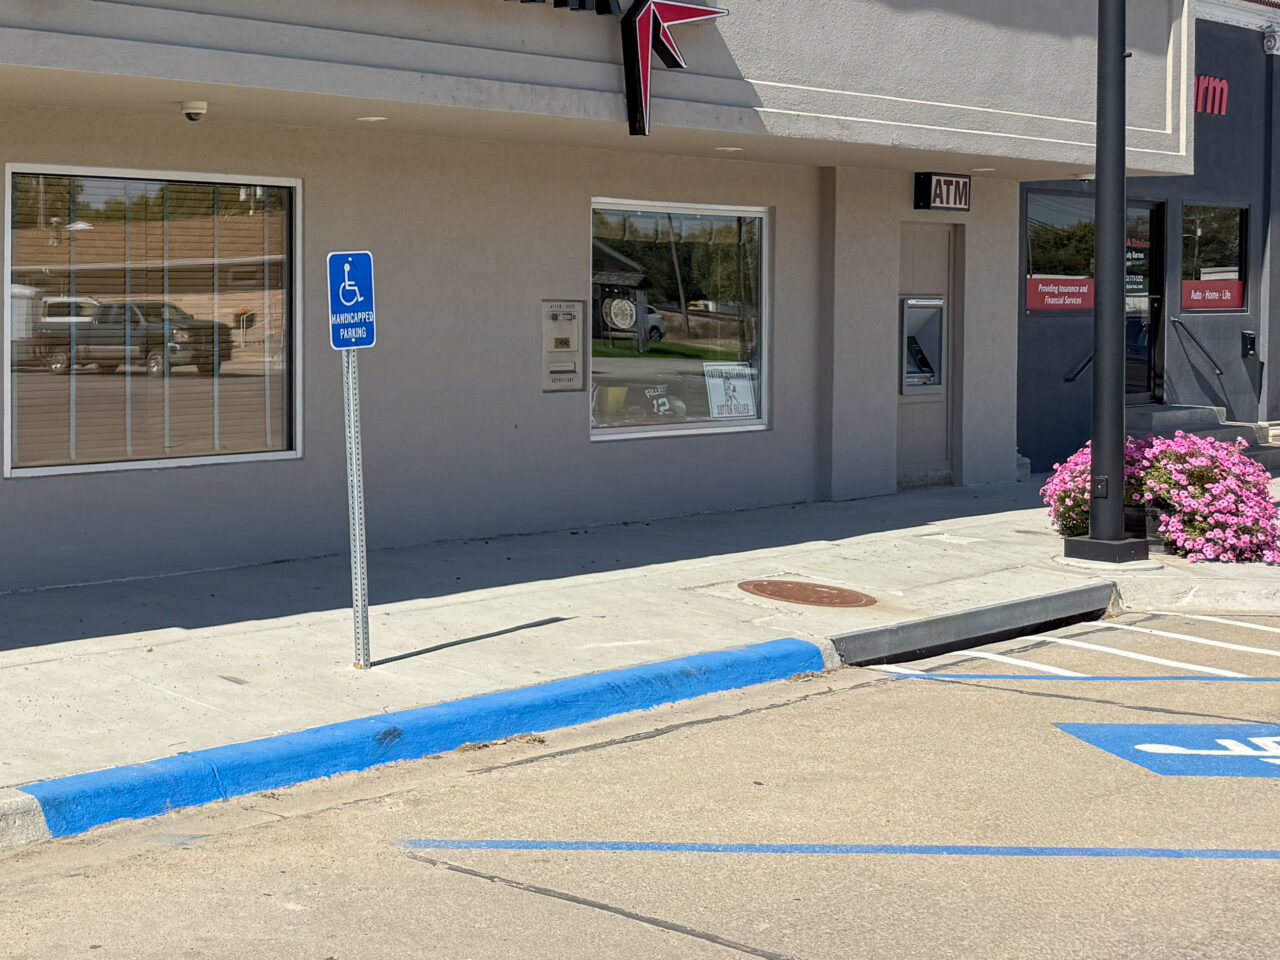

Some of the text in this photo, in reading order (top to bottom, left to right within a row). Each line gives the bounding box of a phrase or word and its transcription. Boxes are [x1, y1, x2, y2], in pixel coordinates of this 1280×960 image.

[932, 178, 968, 206] ATM
[1038, 283, 1088, 294] Providing Insurance and
[1191, 289, 1231, 300] Auto Home Life
[1044, 295, 1082, 304] Financial Services
[331, 311, 374, 324] HANDICAPPED
[340, 326, 366, 339] PARKING
[652, 397, 673, 415] 12
